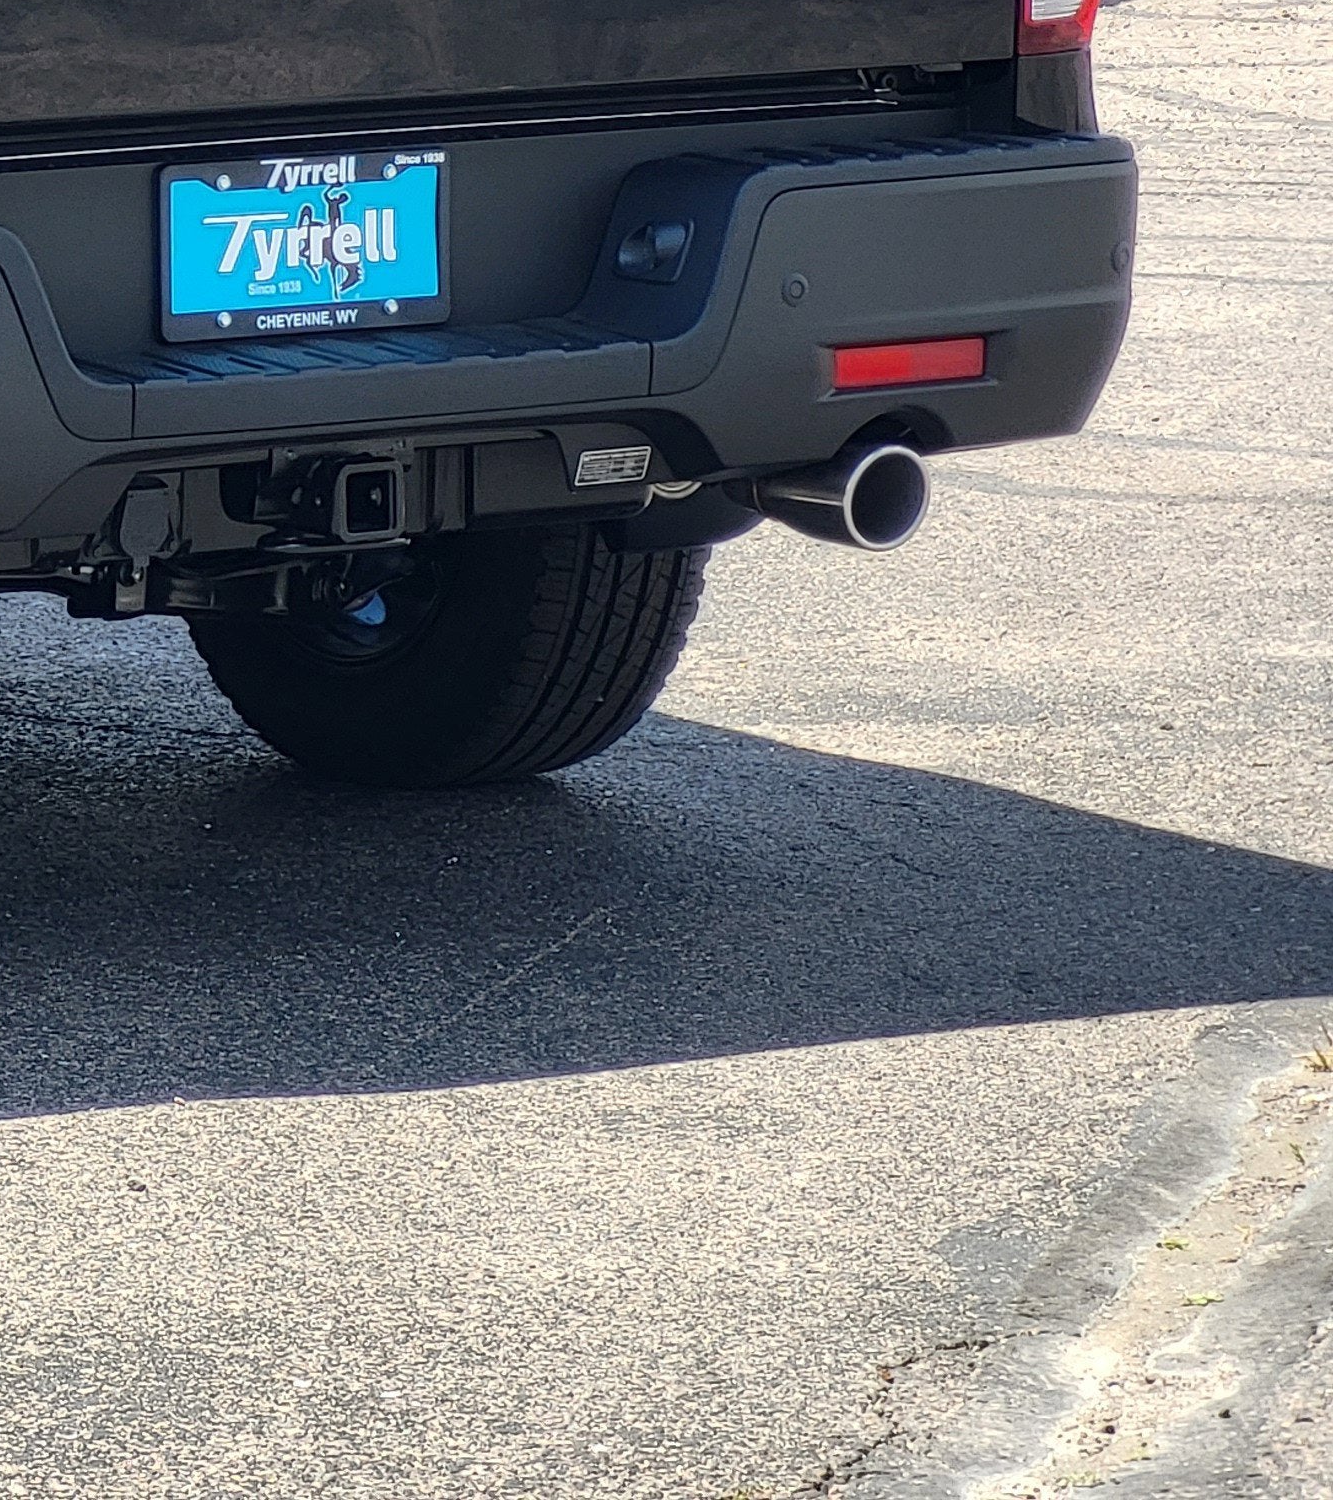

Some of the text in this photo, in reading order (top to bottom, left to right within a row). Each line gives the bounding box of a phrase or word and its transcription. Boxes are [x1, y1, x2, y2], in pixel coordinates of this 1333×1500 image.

[260, 155, 357, 192] Tyrrell
[202, 208, 398, 282] Tyrrell
[256, 309, 359, 331] CHEYENNE, WY
